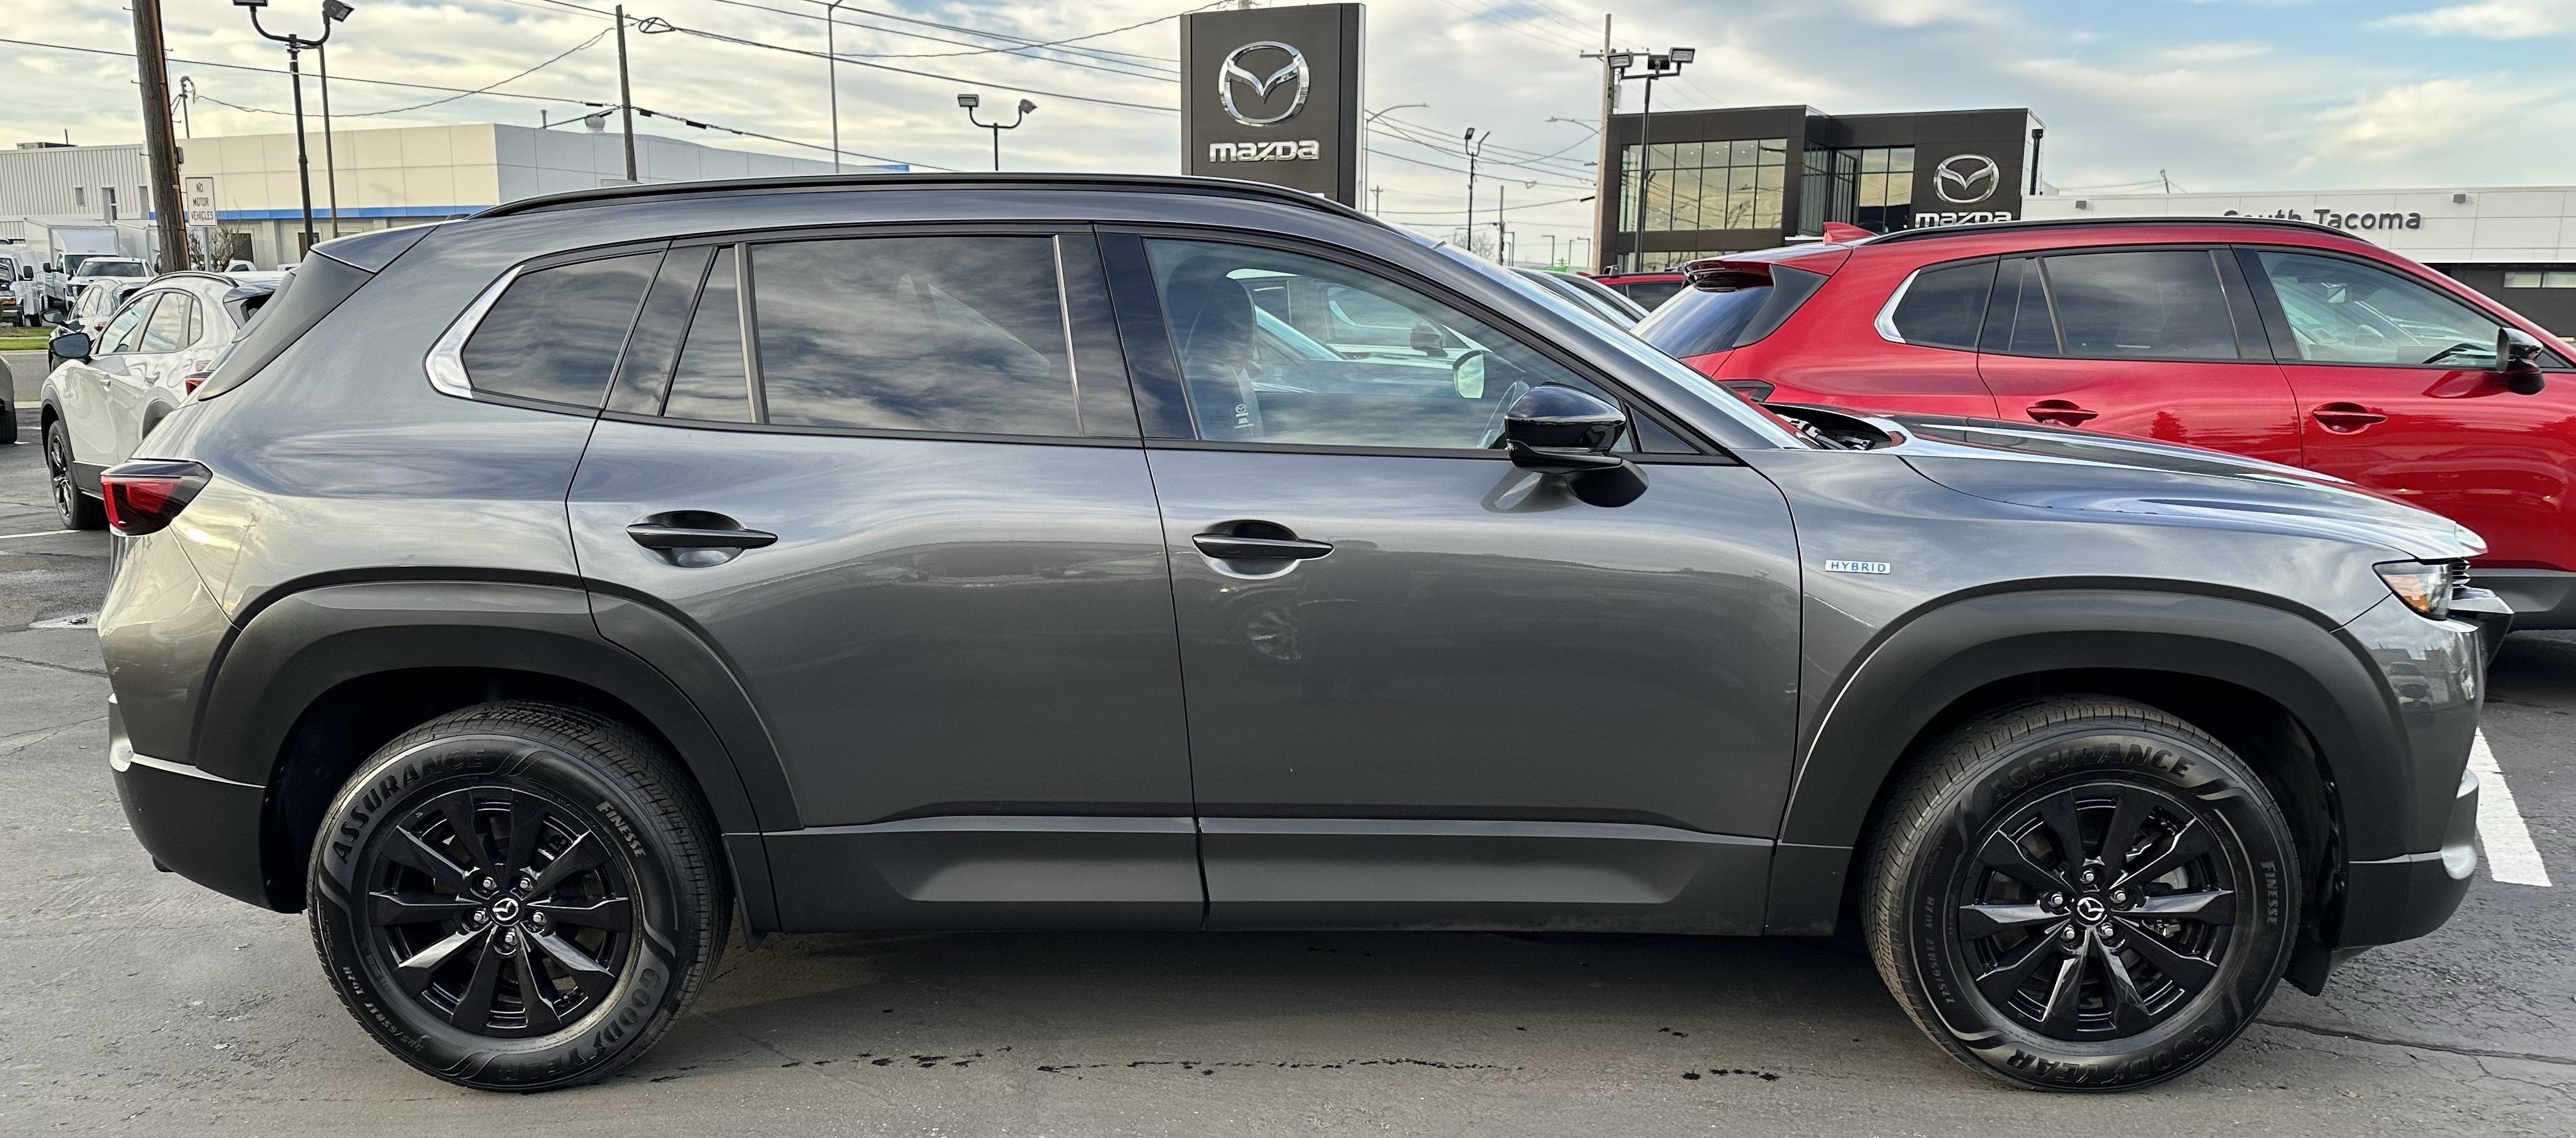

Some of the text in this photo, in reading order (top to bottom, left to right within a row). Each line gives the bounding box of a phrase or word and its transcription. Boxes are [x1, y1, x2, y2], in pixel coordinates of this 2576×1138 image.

[196, 182, 203, 193] NO
[192, 197, 209, 207] MOTOR
[191, 210, 214, 220] VEHICLES
[2314, 209, 2421, 229] Tacoma
[1831, 562, 1886, 572] HYBRID
[1990, 742, 2196, 807] ASSURANCE
[332, 748, 486, 865] ASSURANCE
[596, 801, 647, 857] FINESSE
[2260, 860, 2279, 926] FINESSE
